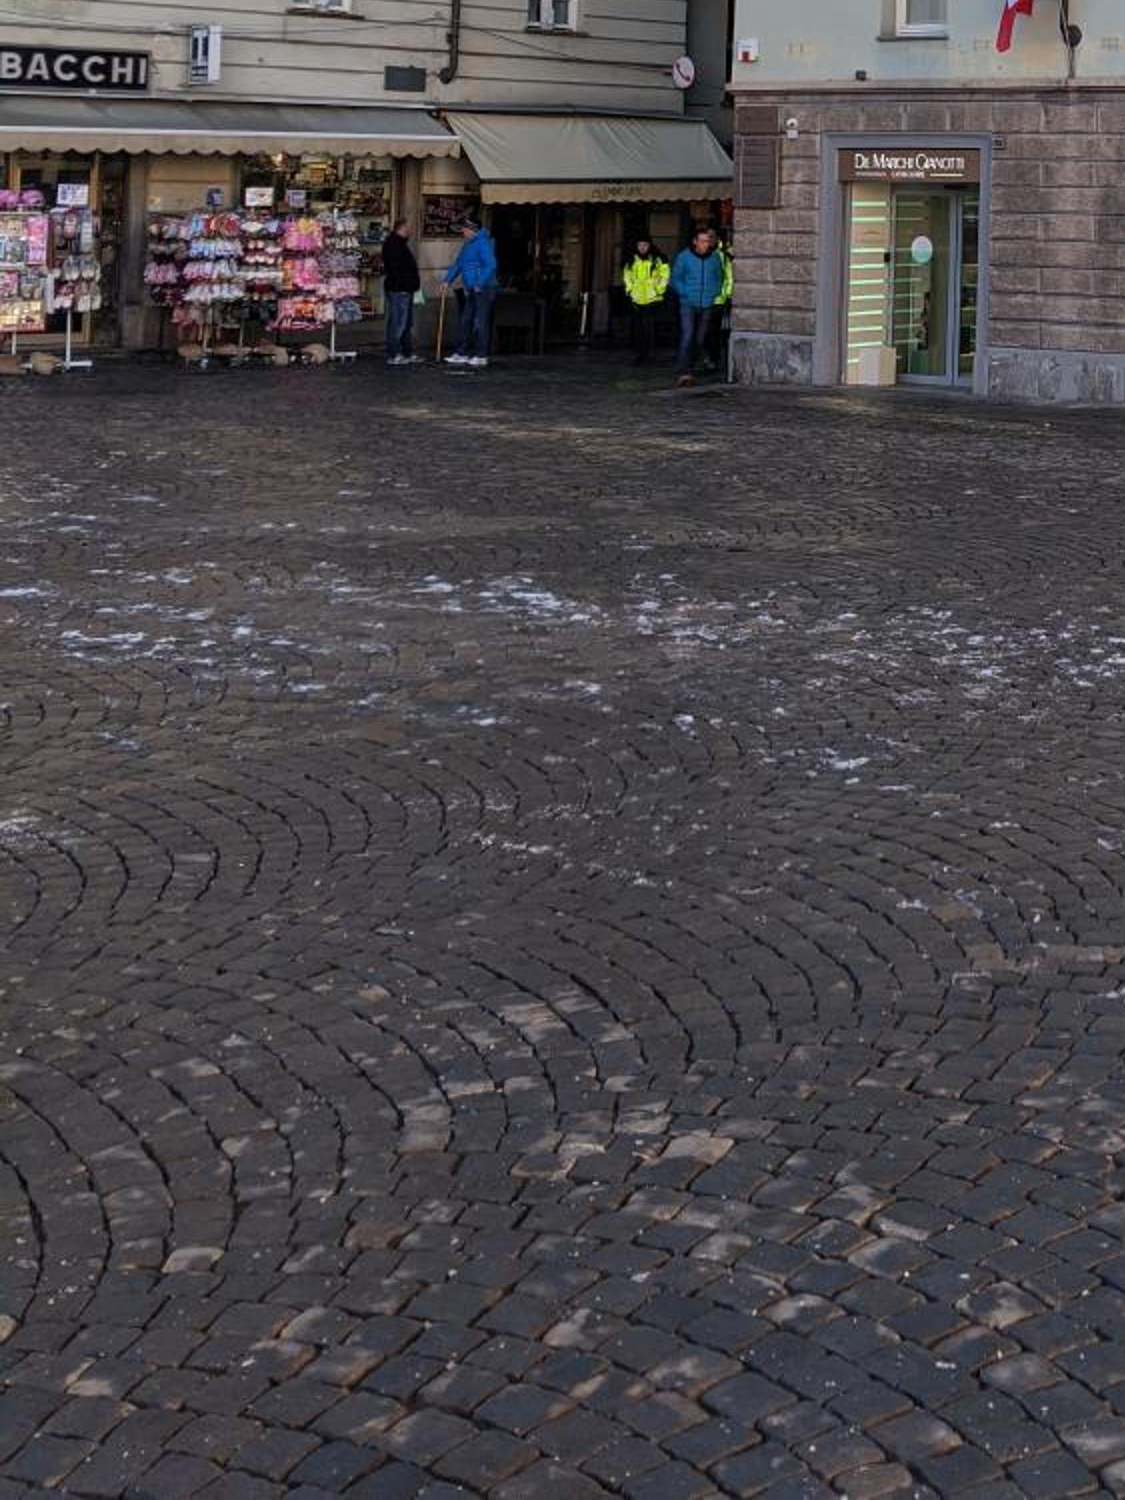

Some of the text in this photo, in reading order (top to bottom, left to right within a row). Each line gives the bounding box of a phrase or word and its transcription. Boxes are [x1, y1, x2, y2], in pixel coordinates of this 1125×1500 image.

[0, 52, 146, 84] BACCHI
[854, 153, 965, 169] DE MARCHI GIANOTTI
